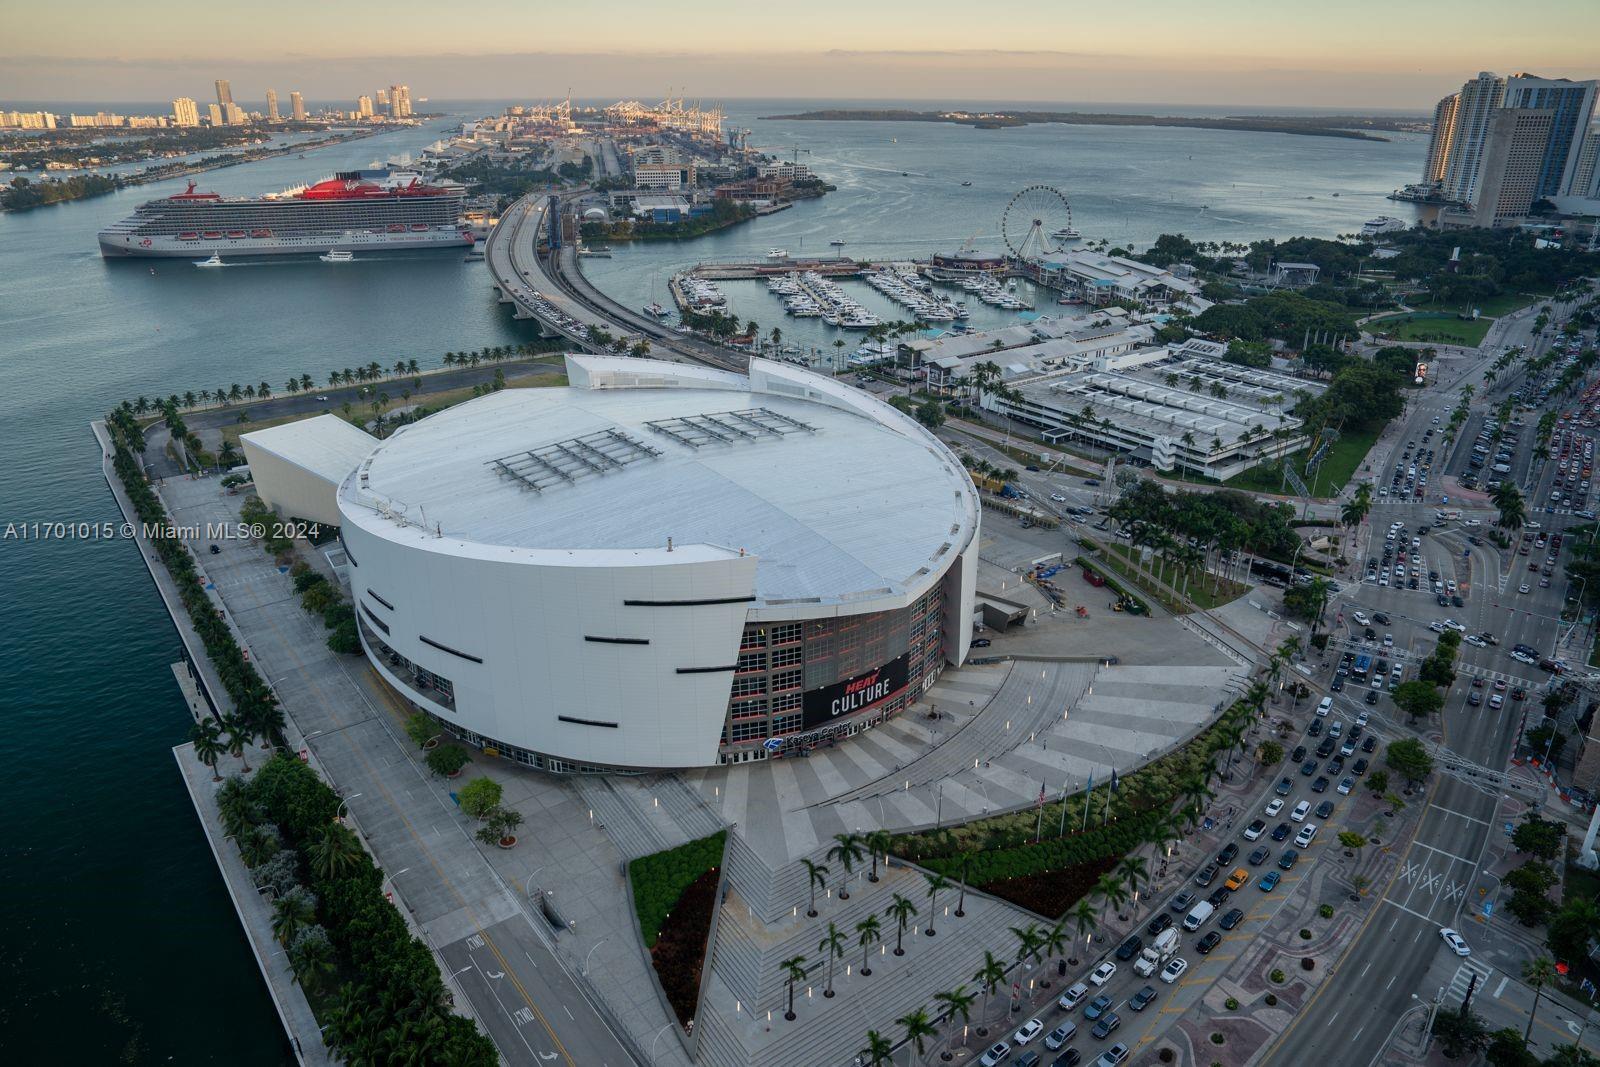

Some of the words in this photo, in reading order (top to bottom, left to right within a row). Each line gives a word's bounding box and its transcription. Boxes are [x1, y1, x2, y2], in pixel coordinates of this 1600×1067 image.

[845, 671, 880, 694] HEAT
[831, 678, 890, 716] CULTURE
[821, 721, 852, 738] Center
[466, 934, 485, 951] ONLY
[513, 1006, 535, 1026] ONLY
